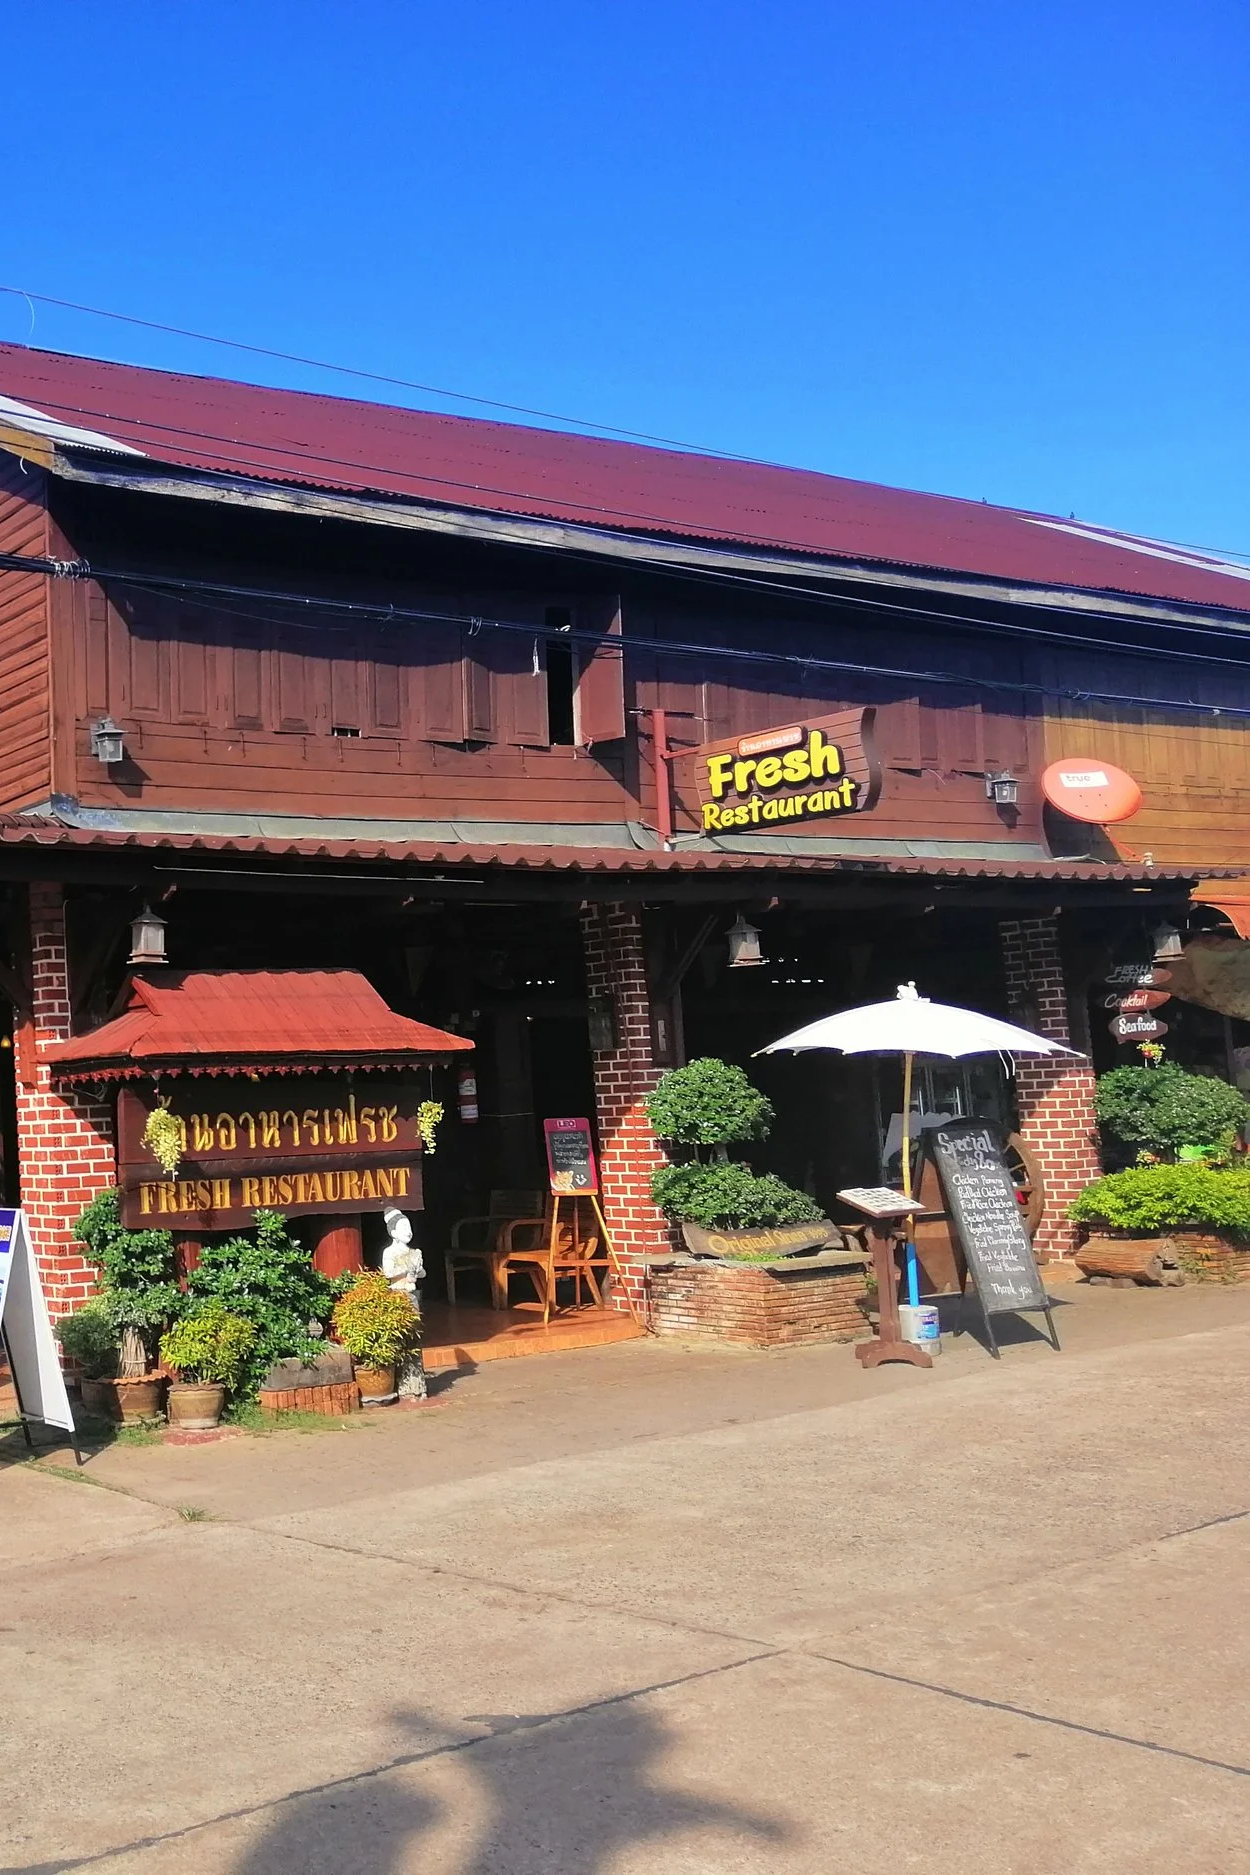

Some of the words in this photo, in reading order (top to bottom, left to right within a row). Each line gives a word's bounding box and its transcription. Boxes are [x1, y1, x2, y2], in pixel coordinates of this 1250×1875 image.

[706, 730, 840, 797] Fresh
[1065, 774, 1092, 782] true
[702, 777, 855, 830] Restaurant
[1114, 965, 1149, 975] FRESH
[1119, 1017, 1157, 1035] Seafood
[937, 1129, 997, 1161] Special
[139, 1178, 233, 1215] FRESH
[241, 1167, 411, 1207] RESTAURANT
[708, 1231, 777, 1256] Original
[990, 1279, 1017, 1295] Thank
[1017, 1286, 1033, 1300] you
